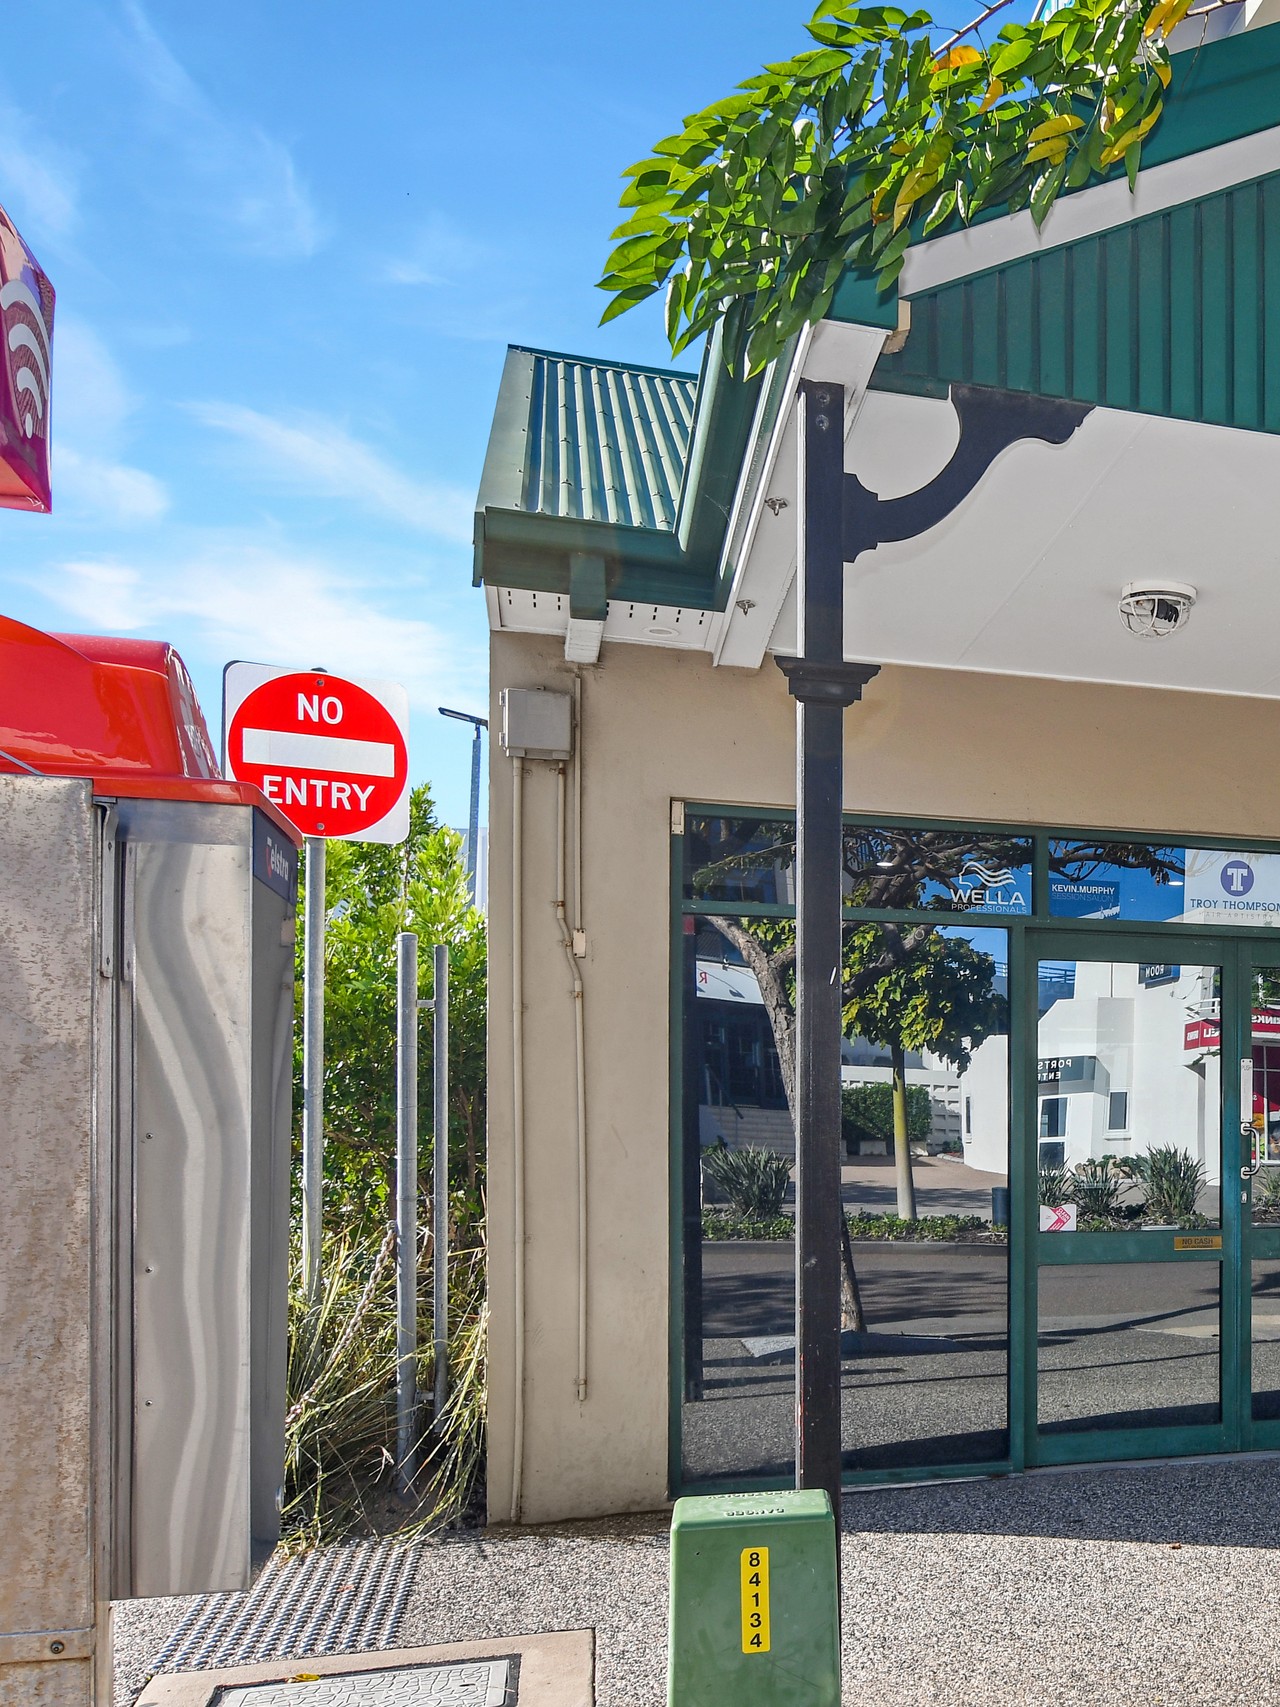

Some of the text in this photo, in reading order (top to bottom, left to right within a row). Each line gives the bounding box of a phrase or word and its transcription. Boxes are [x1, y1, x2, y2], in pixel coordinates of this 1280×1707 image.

[297, 693, 343, 725] NO
[263, 775, 375, 812] ENTRY
[1052, 884, 1115, 895] KEVIN.MURPHY
[950, 889, 1026, 906] WELLA
[1051, 893, 1114, 903] SESSION SALON
[951, 903, 1027, 914] PROFESSIONALS
[1190, 898, 1219, 909] TROY
[1227, 912, 1274, 920] ARTISTRY
[1194, 1237, 1214, 1245] CASH
[748, 1552, 763, 1648] 84134
